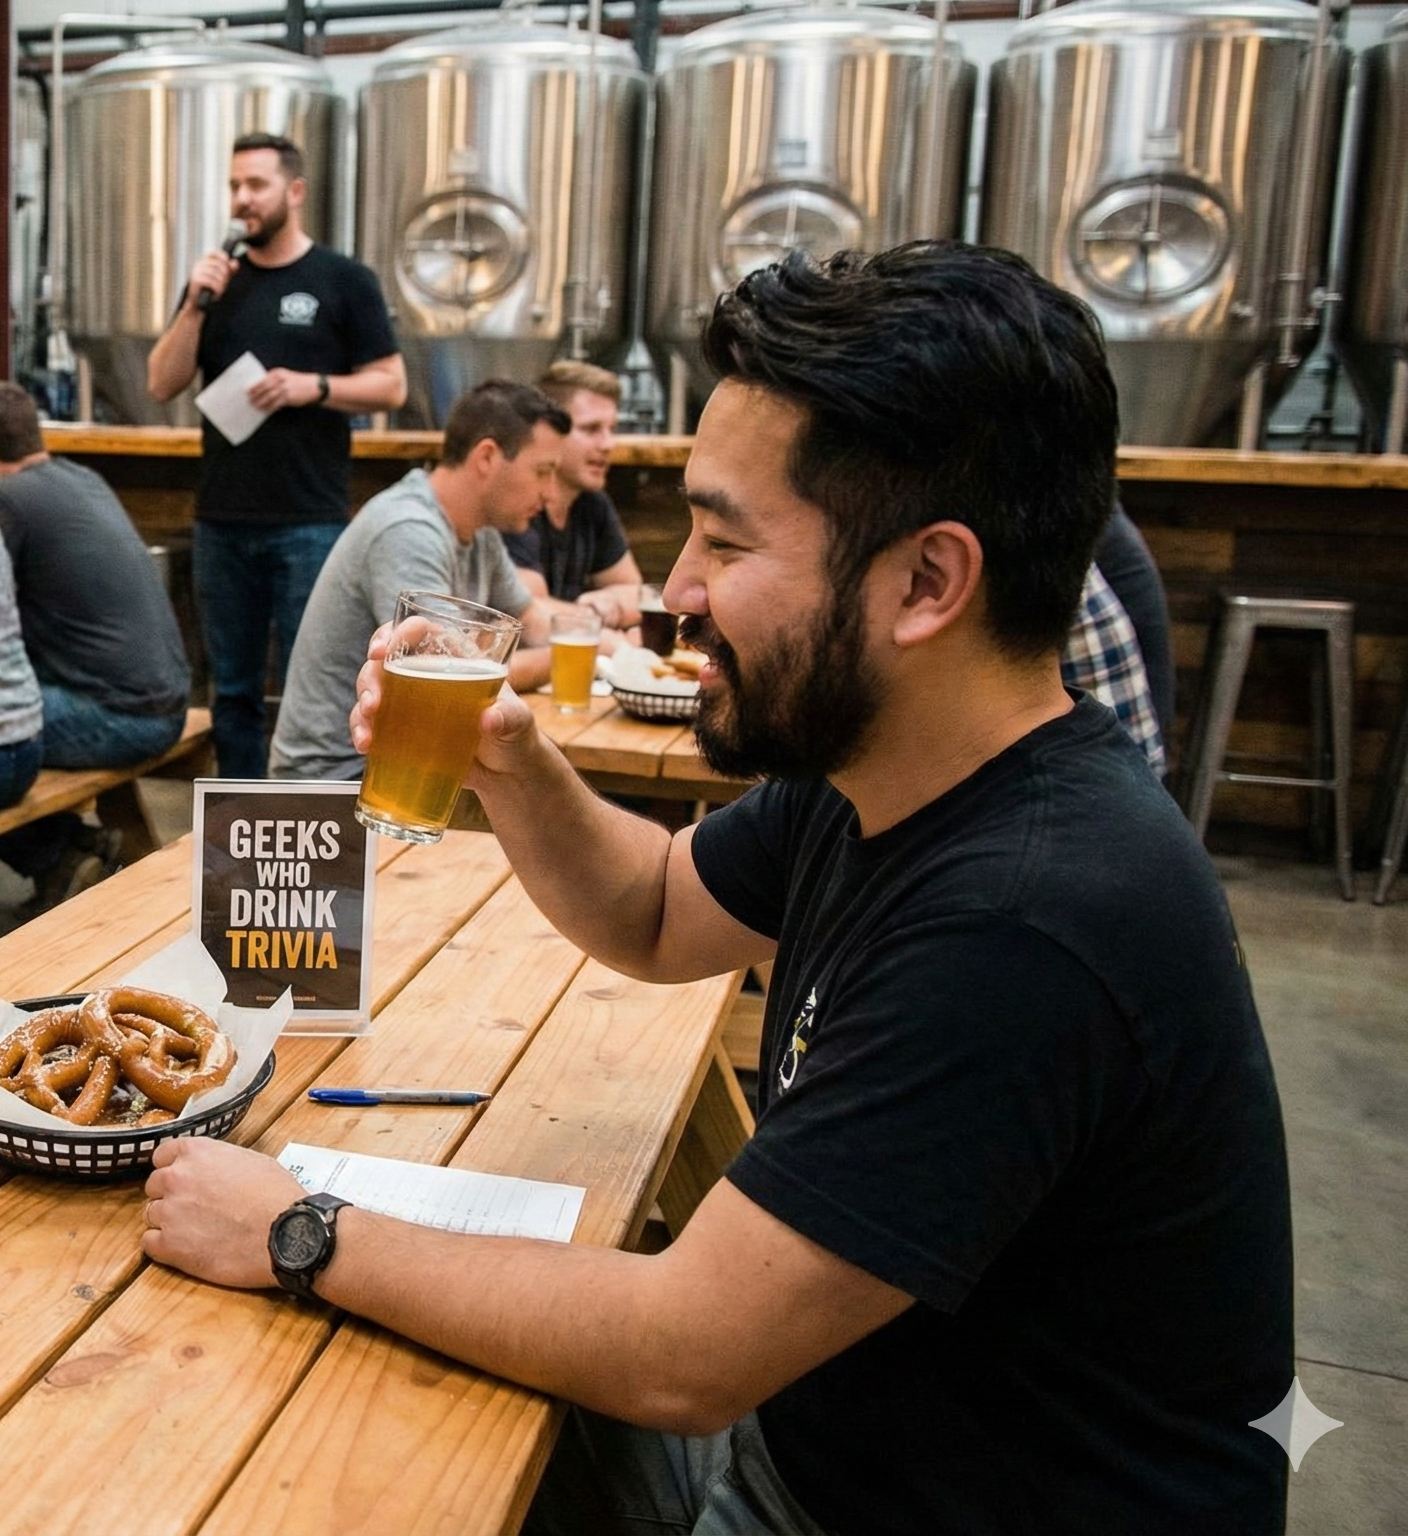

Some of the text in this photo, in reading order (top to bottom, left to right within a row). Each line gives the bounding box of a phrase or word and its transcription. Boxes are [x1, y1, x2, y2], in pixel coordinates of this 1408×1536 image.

[229, 818, 341, 860] GEEKS
[256, 861, 311, 888] WHO
[229, 888, 338, 929] DRINK
[225, 930, 338, 970] TRIVIA
